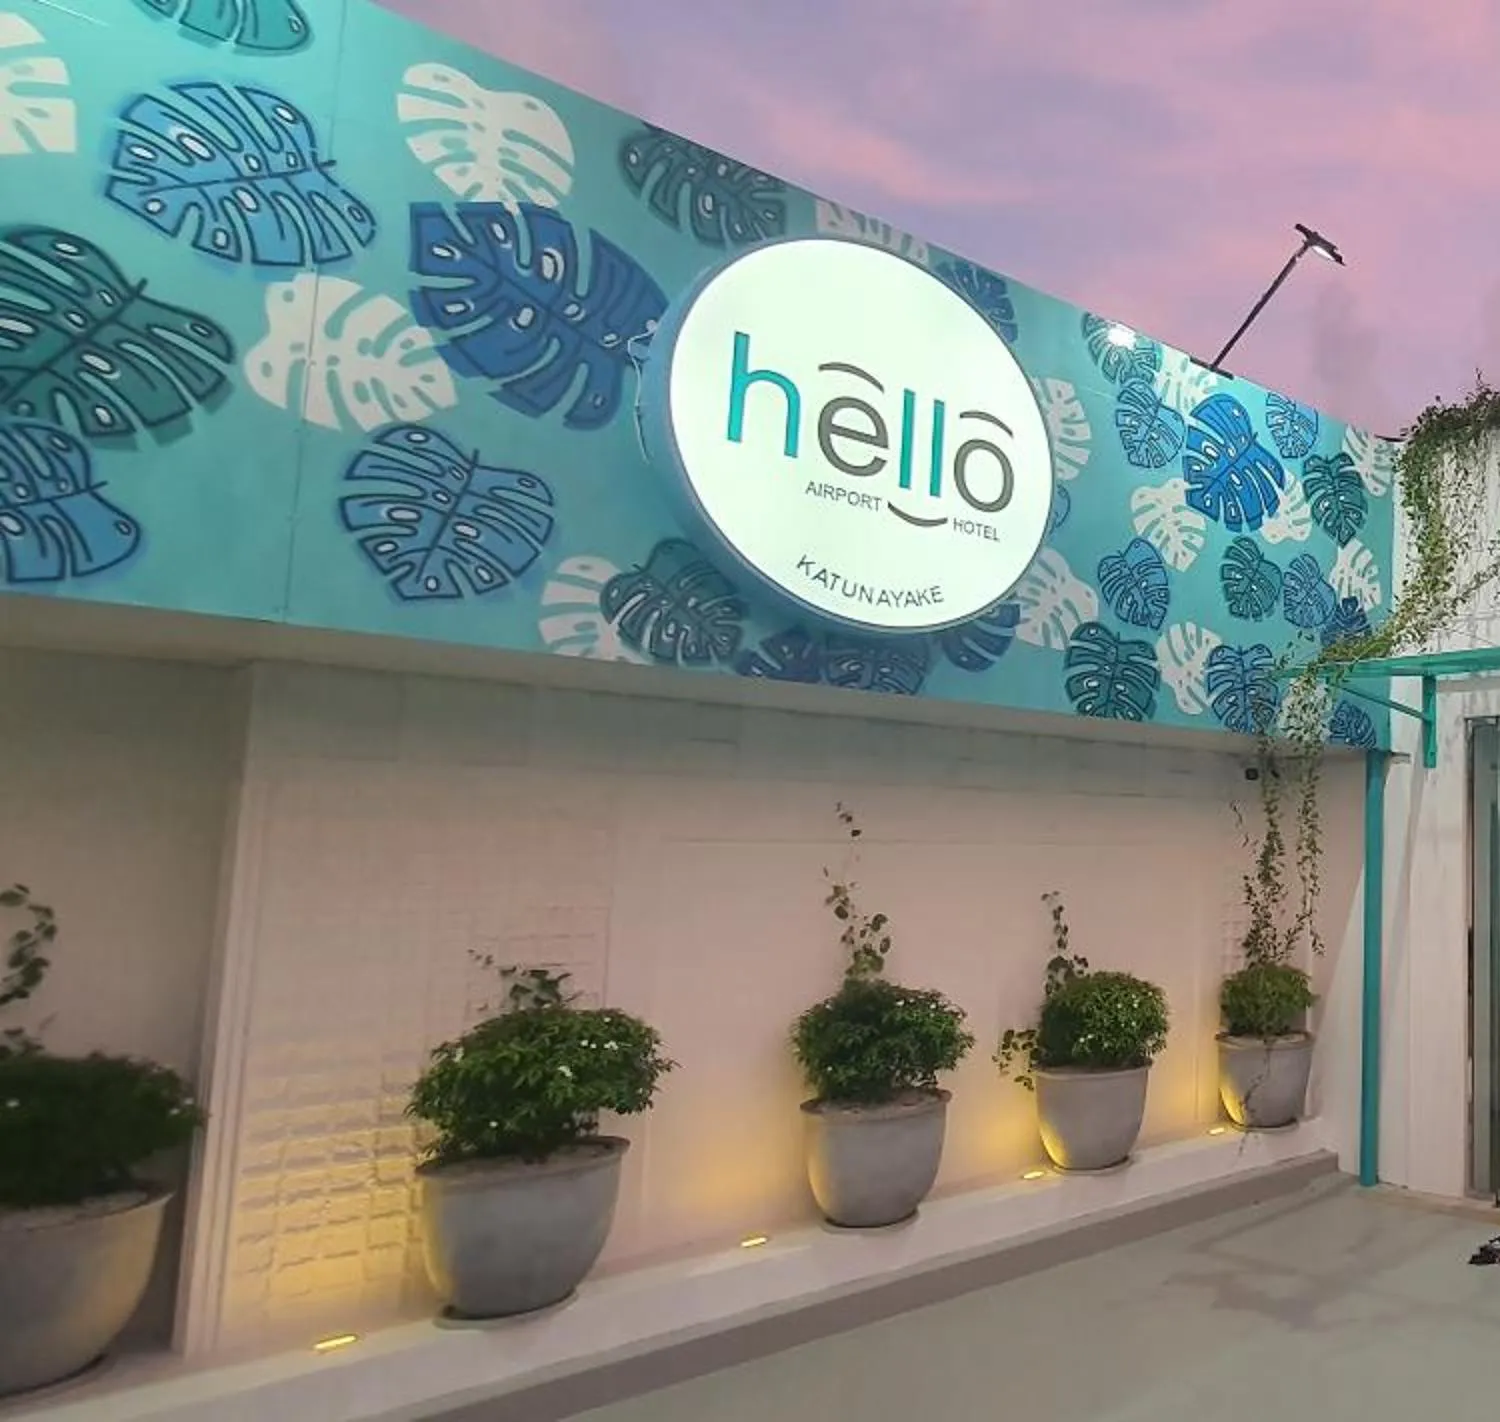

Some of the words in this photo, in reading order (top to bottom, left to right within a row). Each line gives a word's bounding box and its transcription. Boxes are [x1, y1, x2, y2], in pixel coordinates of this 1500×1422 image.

[804, 480, 883, 512] AIRPORT
[953, 517, 1000, 542] HOTEL
[796, 554, 945, 609] KATUNAYAKE
